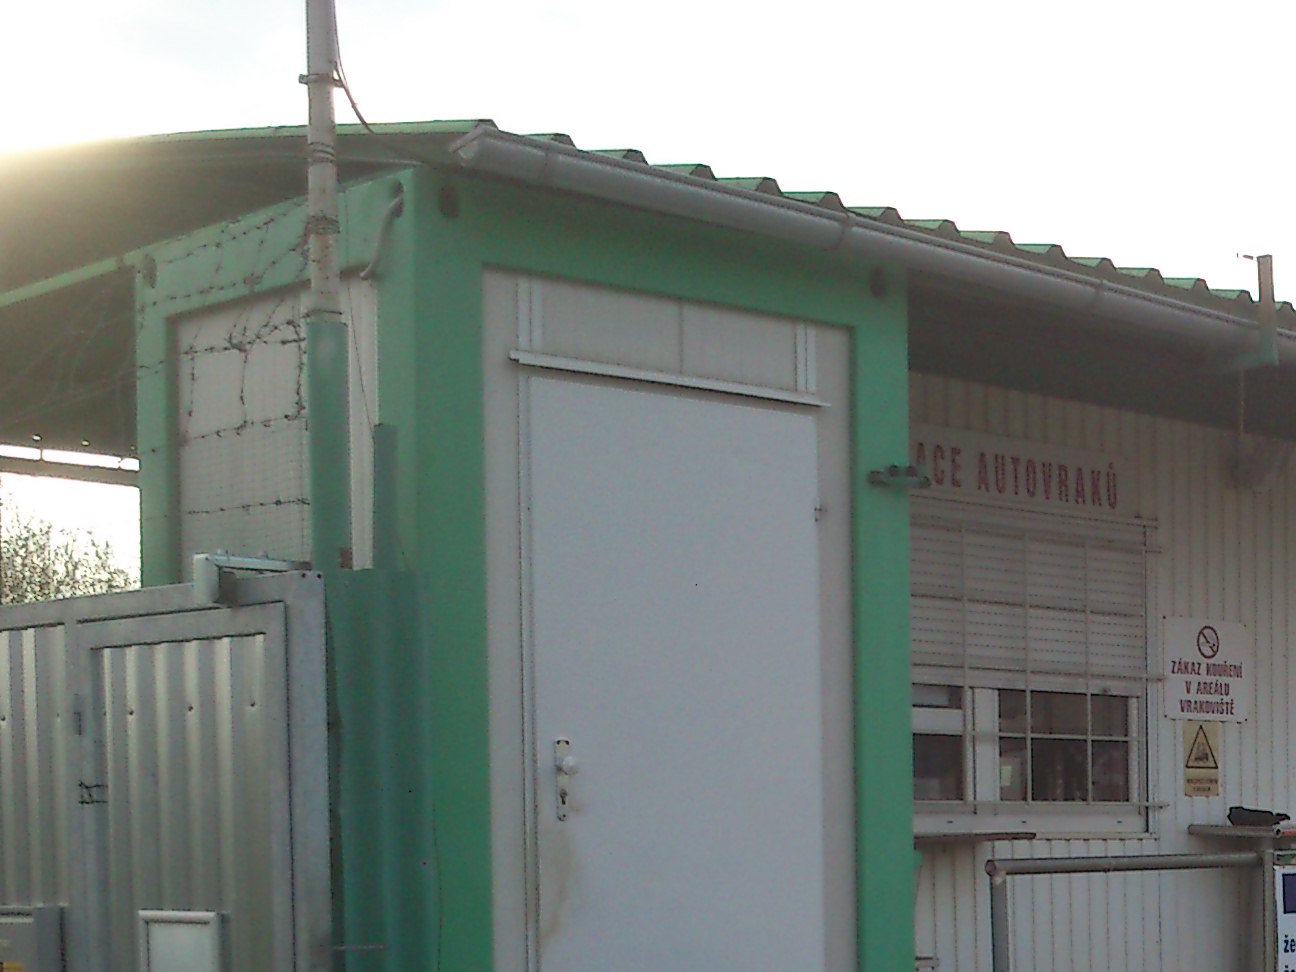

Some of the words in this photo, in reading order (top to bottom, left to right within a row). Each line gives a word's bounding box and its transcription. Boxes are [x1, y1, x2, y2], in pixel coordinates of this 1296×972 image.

[977, 452, 1118, 510] AUTOVRAKŮ
[1171, 658, 1202, 676] ZÁKAZ
[1185, 681, 1192, 695] V
[1196, 680, 1230, 697] AREÁLU
[1180, 699, 1235, 716] VRAKOVIŠTĚ
